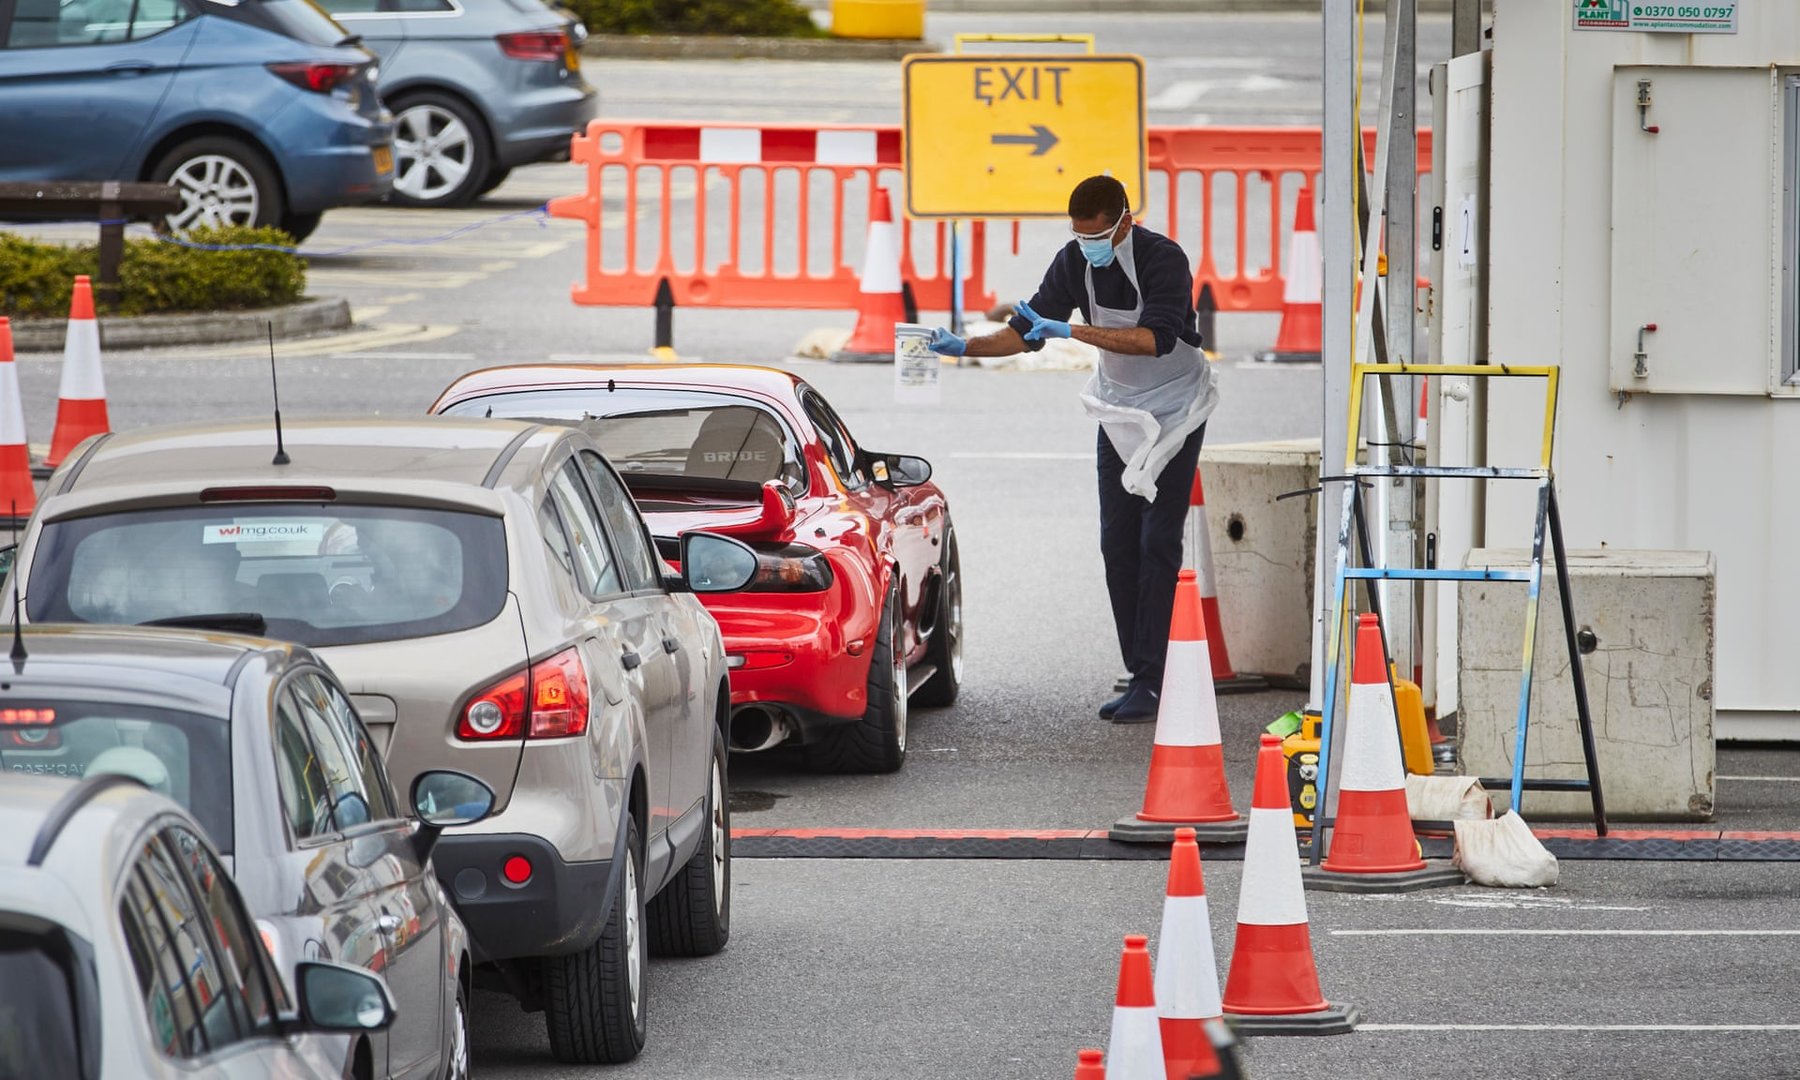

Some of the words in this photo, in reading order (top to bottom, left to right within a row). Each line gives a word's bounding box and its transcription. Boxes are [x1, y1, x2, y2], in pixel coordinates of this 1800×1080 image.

[1578, 10, 1609, 19] PLANT
[1645, 6, 1675, 17] 0370
[1678, 6, 1700, 17] 050
[1703, 7, 1733, 18] 0797
[974, 67, 1071, 102] EXIT
[703, 450, 767, 463] BRIDE
